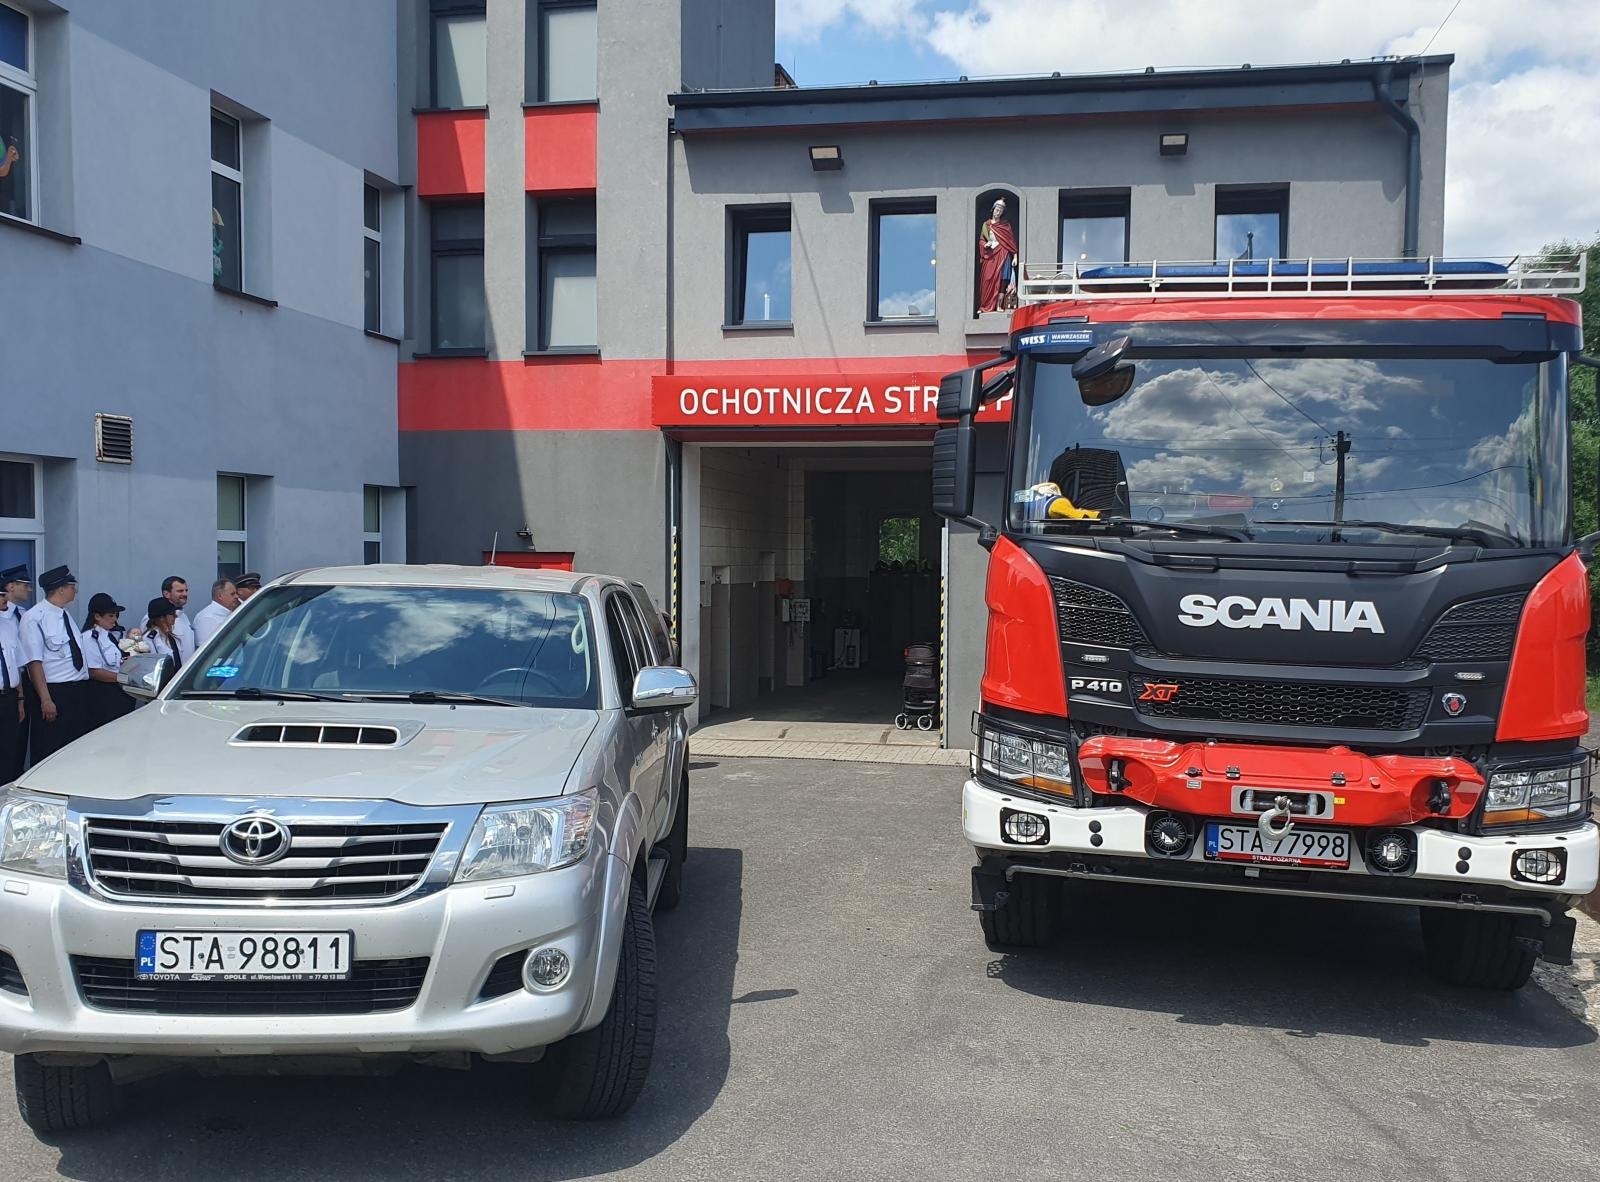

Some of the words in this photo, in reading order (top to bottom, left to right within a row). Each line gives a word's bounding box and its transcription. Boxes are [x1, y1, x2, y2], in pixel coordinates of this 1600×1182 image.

[679, 387, 875, 415] OCHOTNICZA
[1177, 594, 1385, 634] SCANIA
[1071, 679, 1084, 690] P
[1086, 680, 1122, 692] 410
[1138, 682, 1180, 701] XT
[1208, 840, 1217, 848] PL
[1220, 828, 1264, 852] STA
[140, 957, 154, 967] PL
[159, 936, 225, 970] STA
[239, 936, 340, 970] 98811
